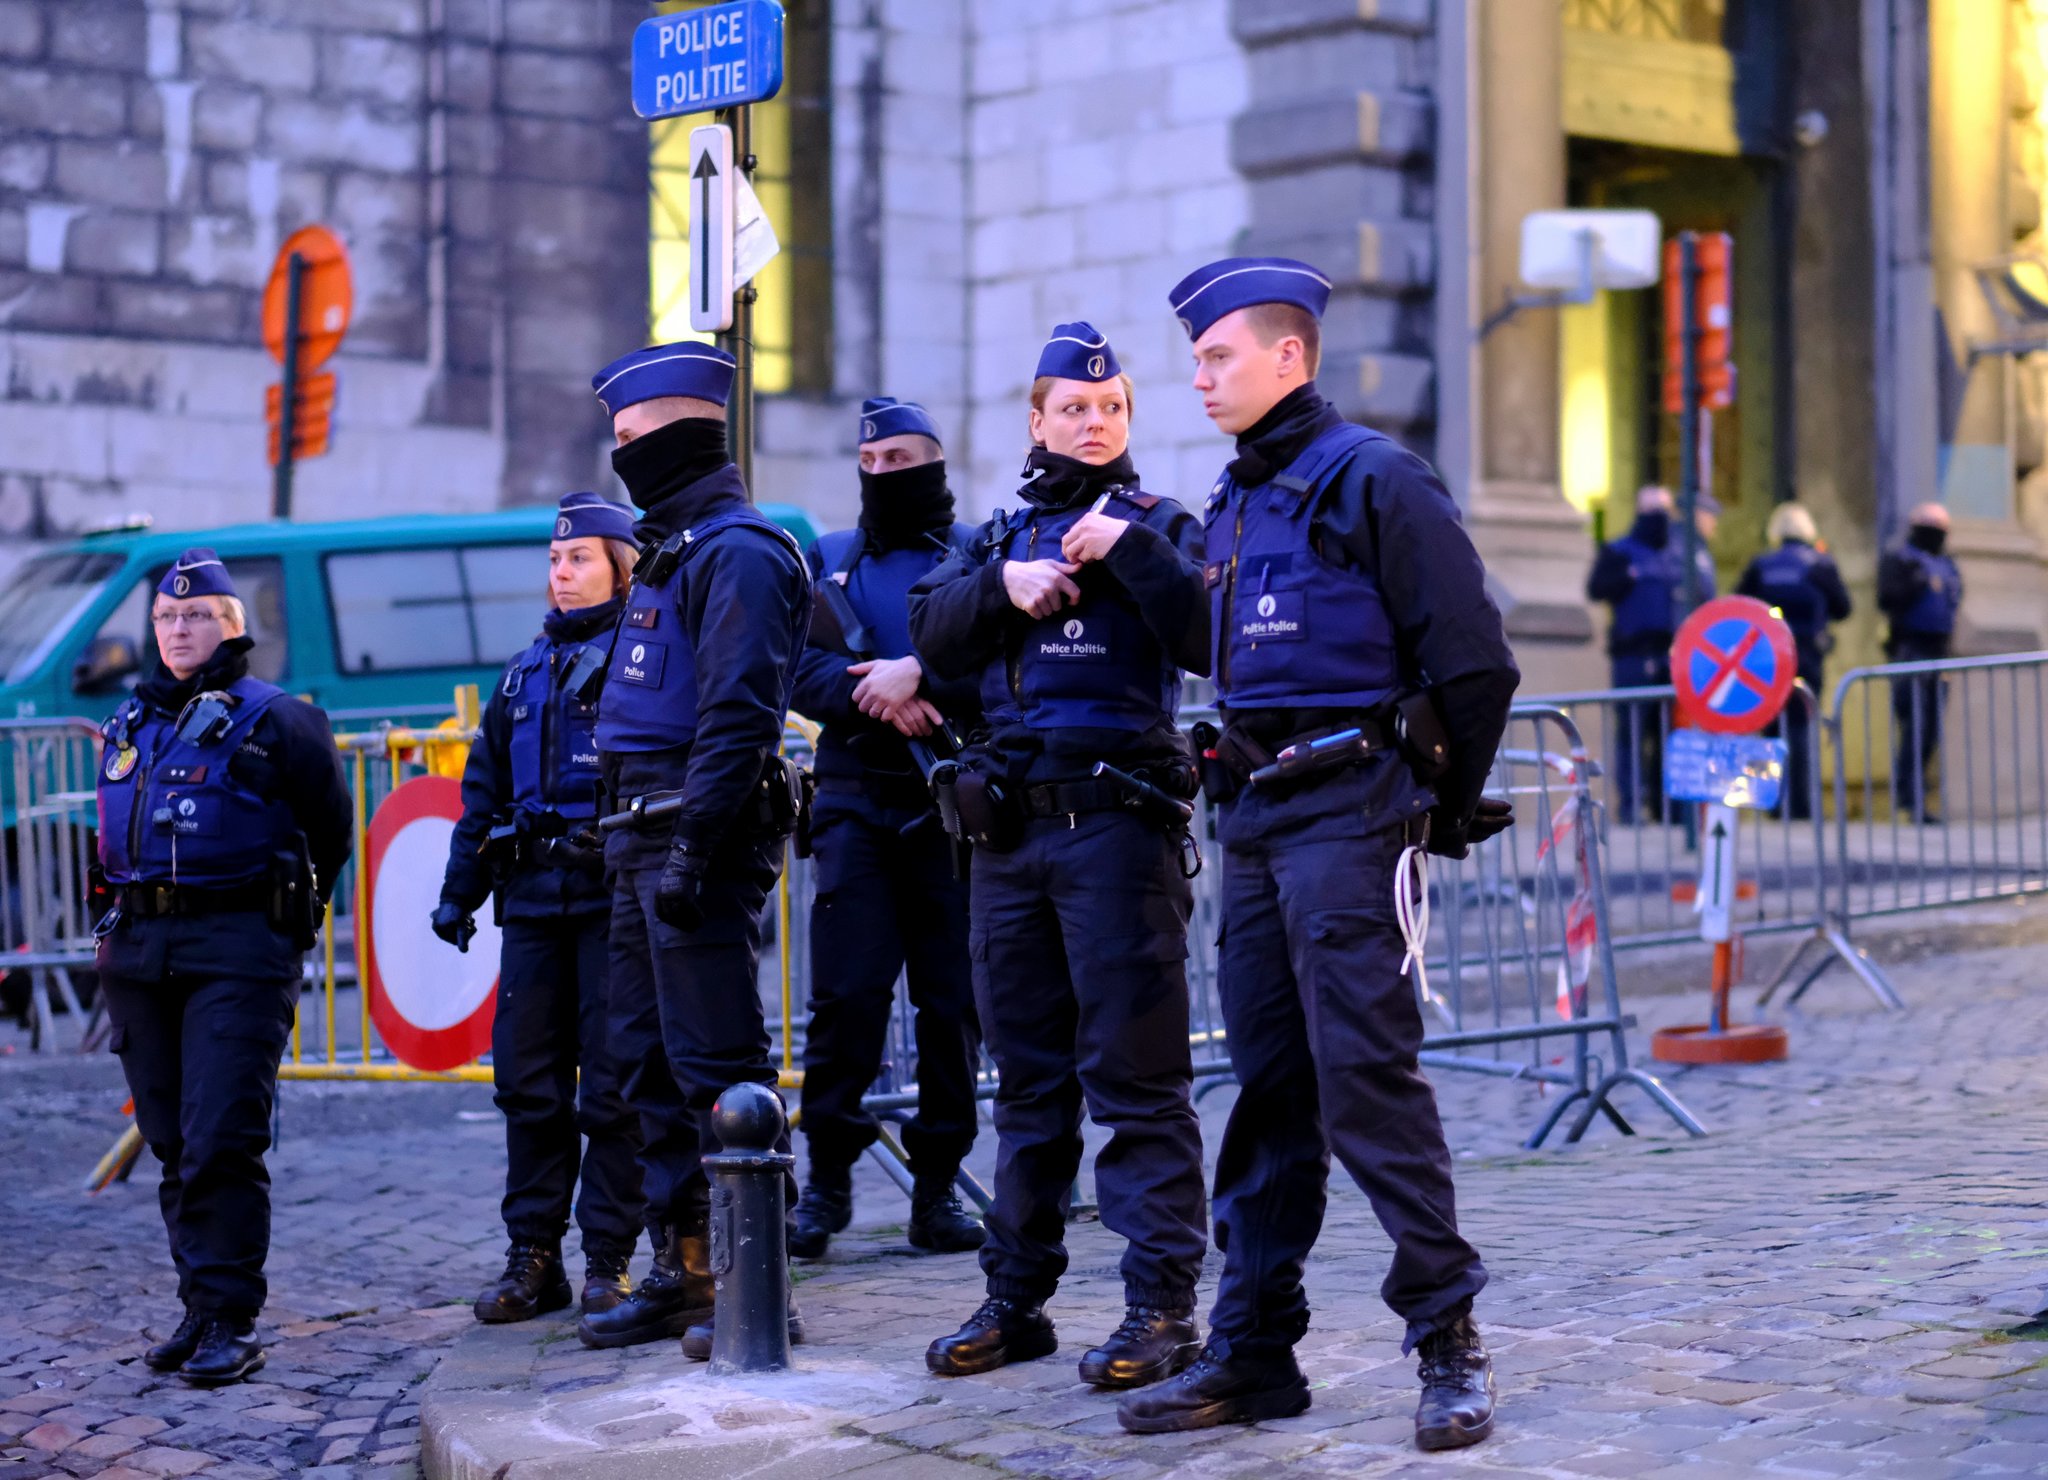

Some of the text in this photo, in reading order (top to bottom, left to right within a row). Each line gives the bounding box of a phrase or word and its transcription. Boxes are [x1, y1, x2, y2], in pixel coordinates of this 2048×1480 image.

[659, 11, 743, 59] POLICE
[656, 60, 746, 108] POLITIE
[1268, 620, 1298, 632] Police
[1041, 643, 1106, 654] Police Politie
[624, 666, 645, 678] Police
[572, 754, 599, 763] Police
